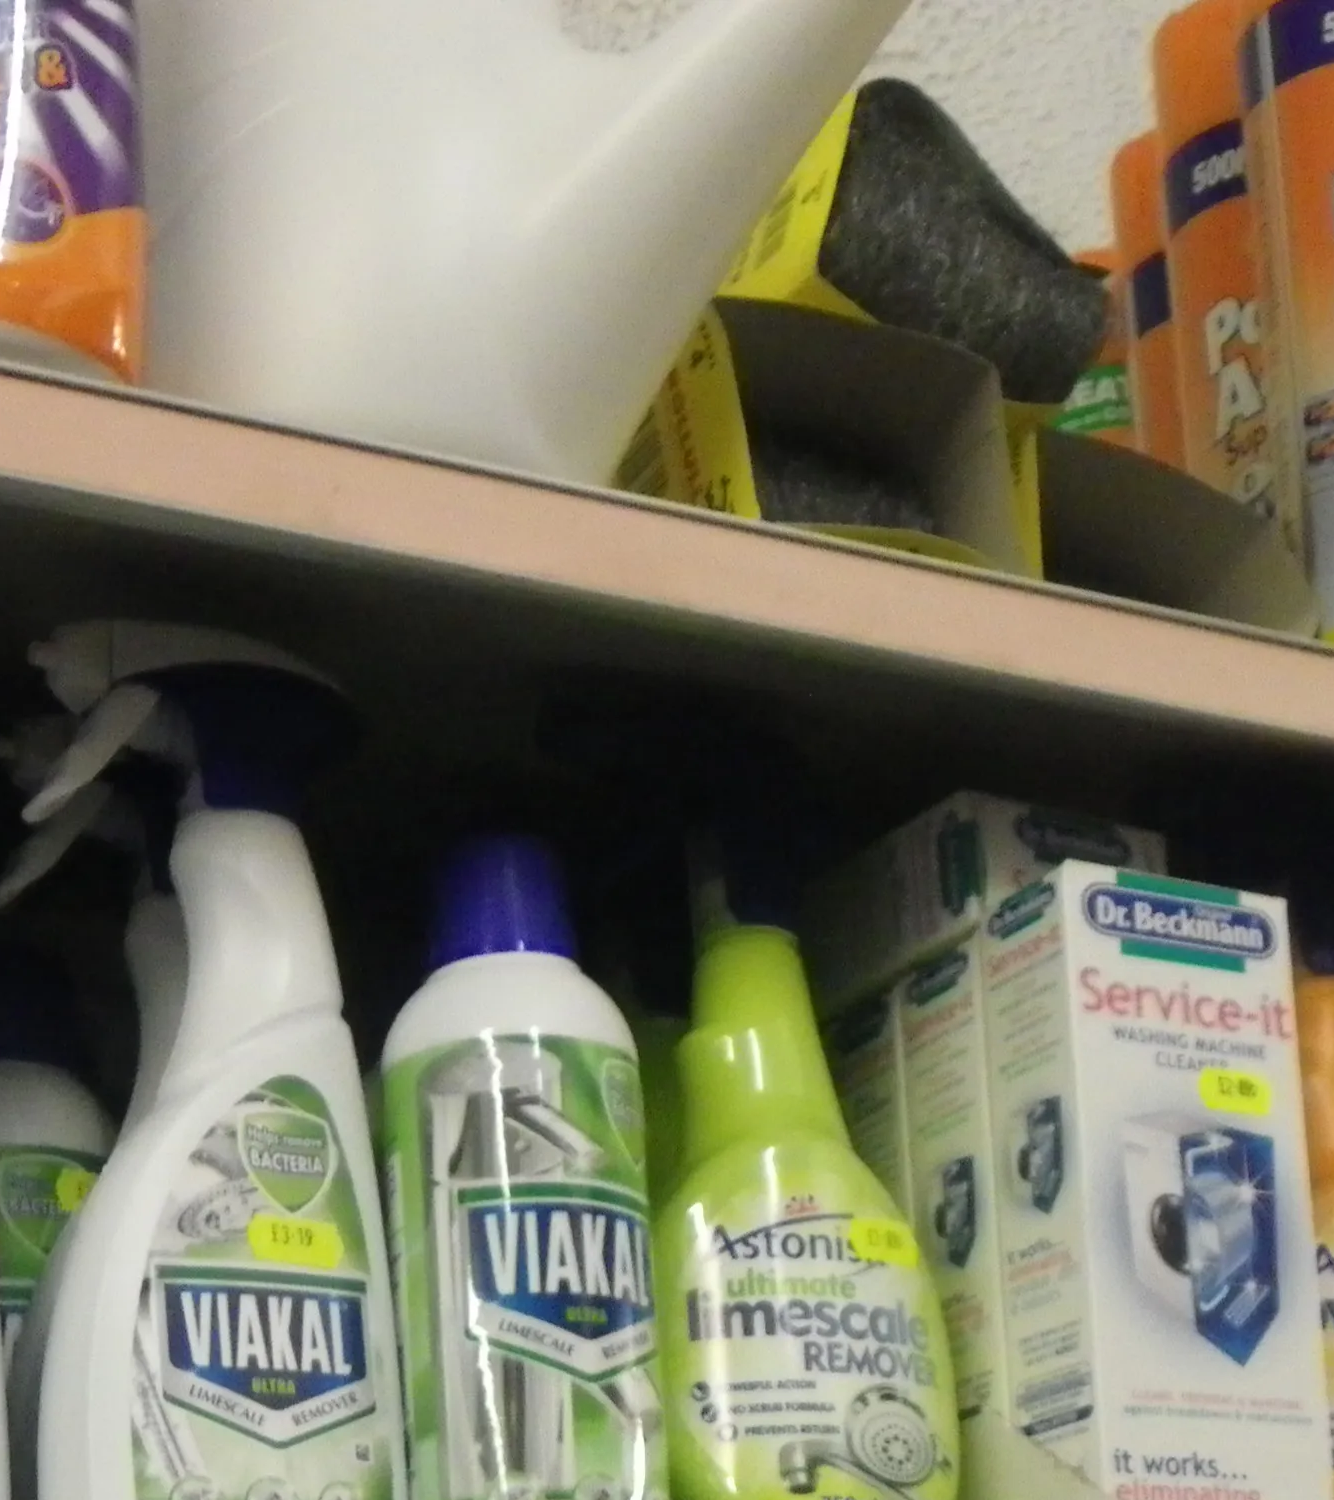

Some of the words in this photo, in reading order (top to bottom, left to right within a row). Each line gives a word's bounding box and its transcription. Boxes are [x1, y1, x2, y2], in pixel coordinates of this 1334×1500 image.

[1095, 895, 1131, 927] Dr.
[1134, 901, 1264, 948] Beckmann
[1079, 966, 1292, 1039] Service-it
[1113, 1026, 1188, 1048] WASHING
[1195, 1037, 1267, 1060] MACHINE
[250, 1146, 323, 1173] BACTERIA
[728, 1268, 856, 1299] ultimate
[180, 1290, 352, 1376] VIAKAL
[687, 1289, 929, 1351] limescale
[187, 1382, 266, 1428] LIMESCALE
[292, 1391, 359, 1428] REMOVER
[1113, 1448, 1133, 1474] it
